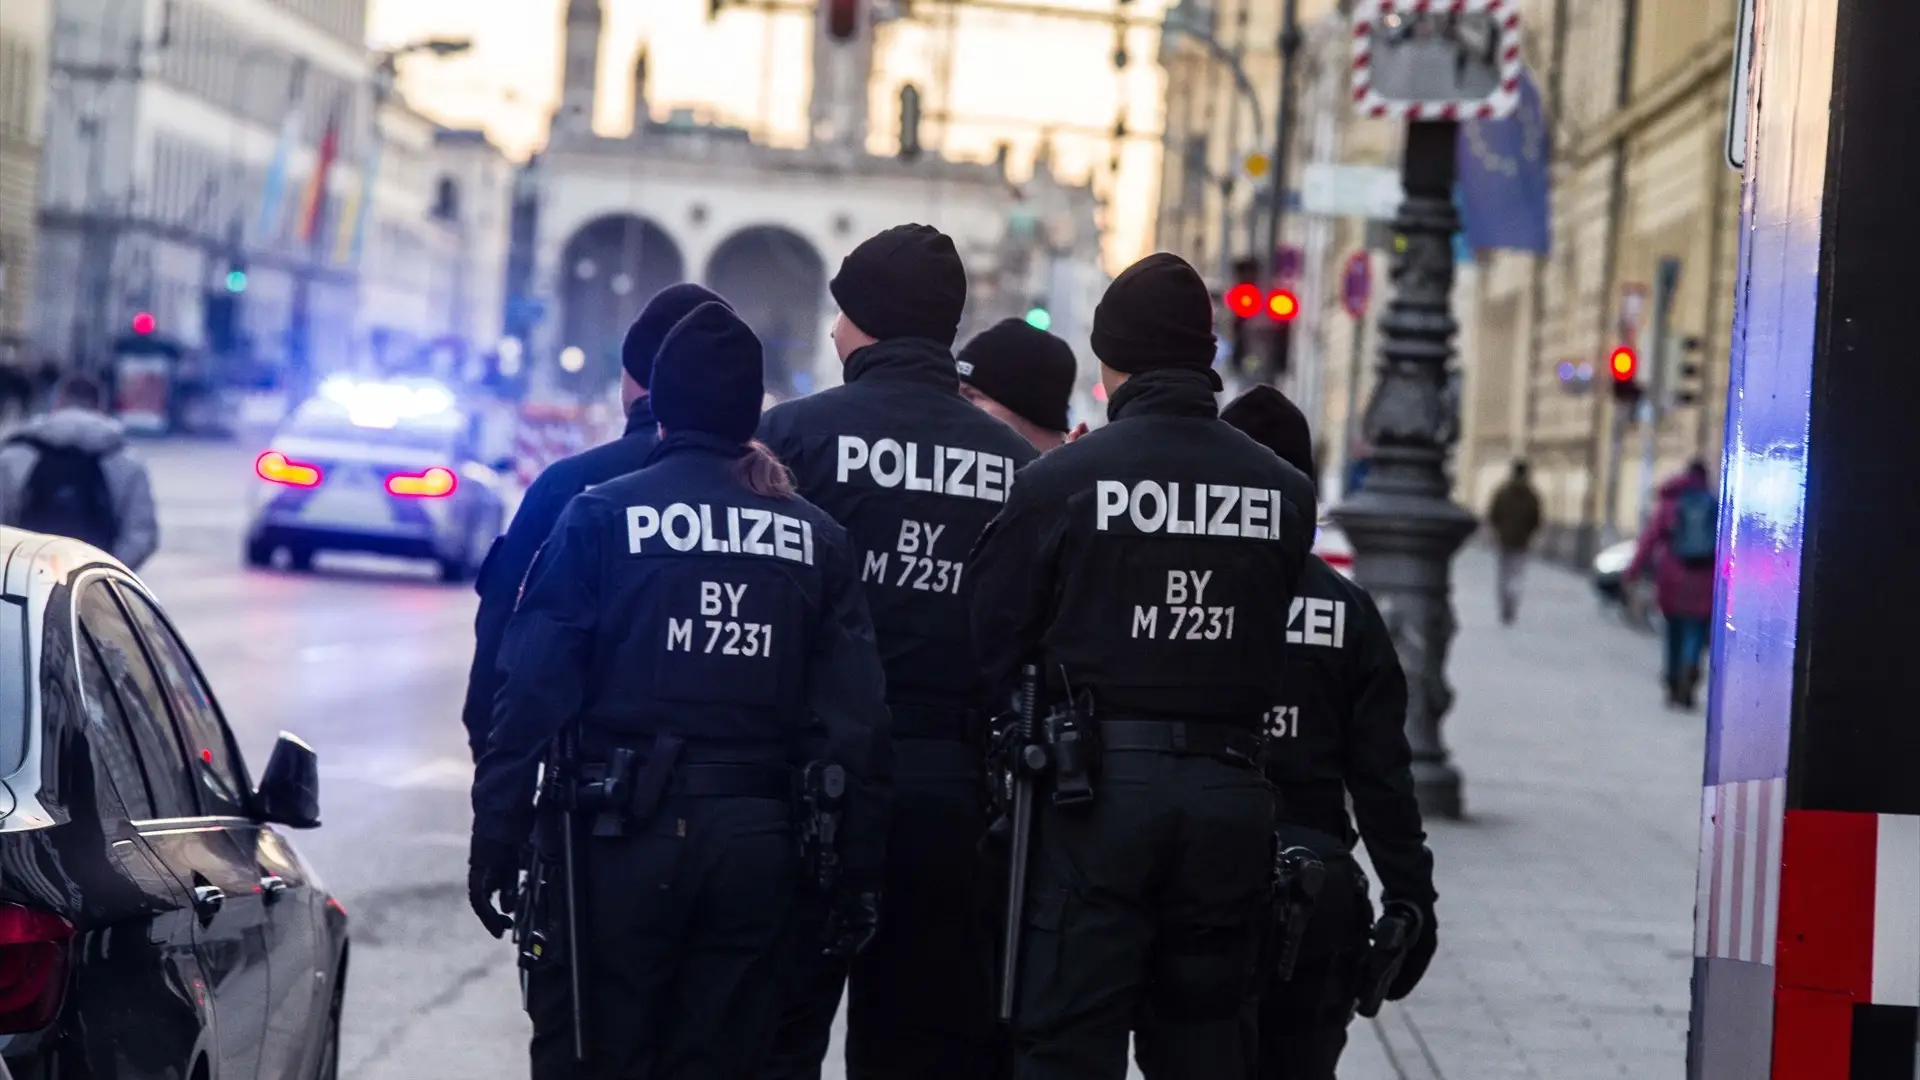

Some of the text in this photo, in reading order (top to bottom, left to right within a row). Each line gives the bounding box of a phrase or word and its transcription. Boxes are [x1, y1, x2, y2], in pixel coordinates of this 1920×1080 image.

[836, 435, 1016, 504] POLIZEI
[1096, 479, 1282, 541] POLIZEI
[626, 502, 814, 566] POLIZEI
[897, 518, 946, 557] BY
[861, 549, 964, 595] M 7231
[1165, 569, 1213, 605] BY
[700, 580, 749, 618] BY
[666, 617, 773, 658] M 7231
[1131, 605, 1236, 641] M 7231
